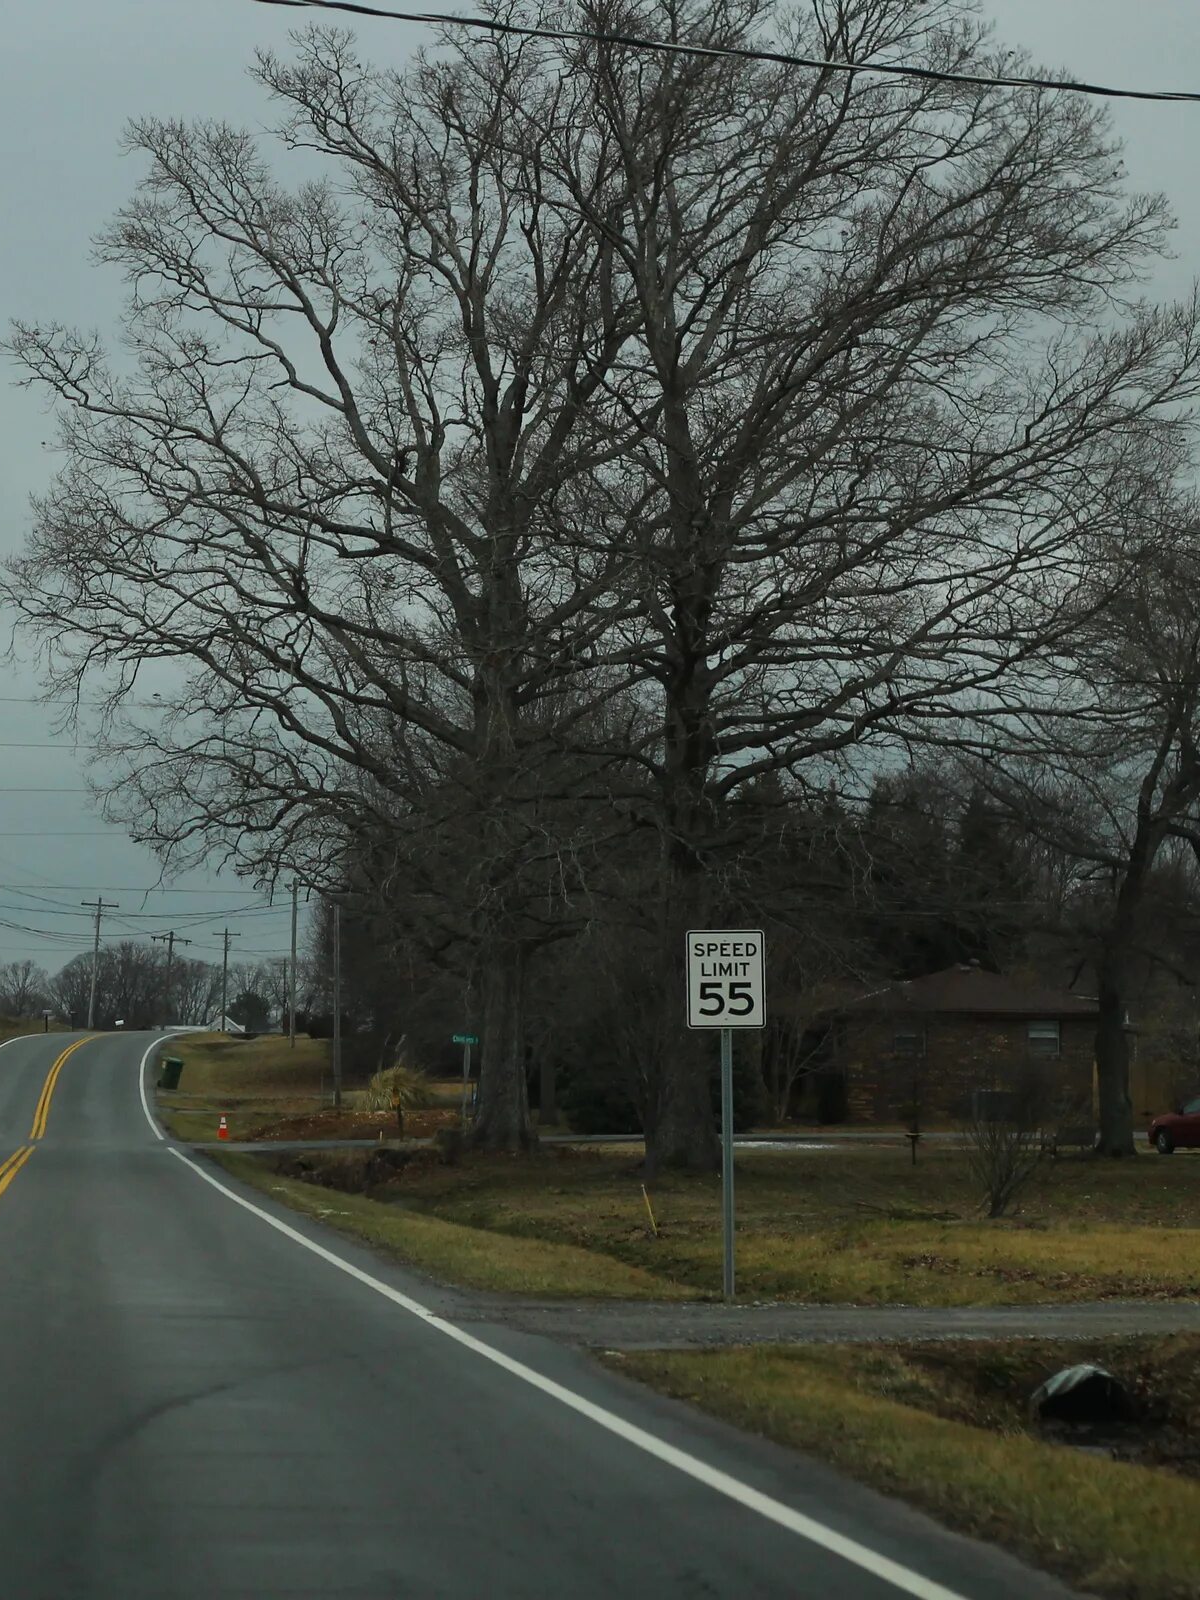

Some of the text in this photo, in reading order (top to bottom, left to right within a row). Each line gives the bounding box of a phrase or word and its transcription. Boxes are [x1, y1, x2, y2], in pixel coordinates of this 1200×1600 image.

[694, 943, 757, 957] SPEED
[701, 962, 750, 976] LIMIT
[699, 982, 754, 1016] 55
